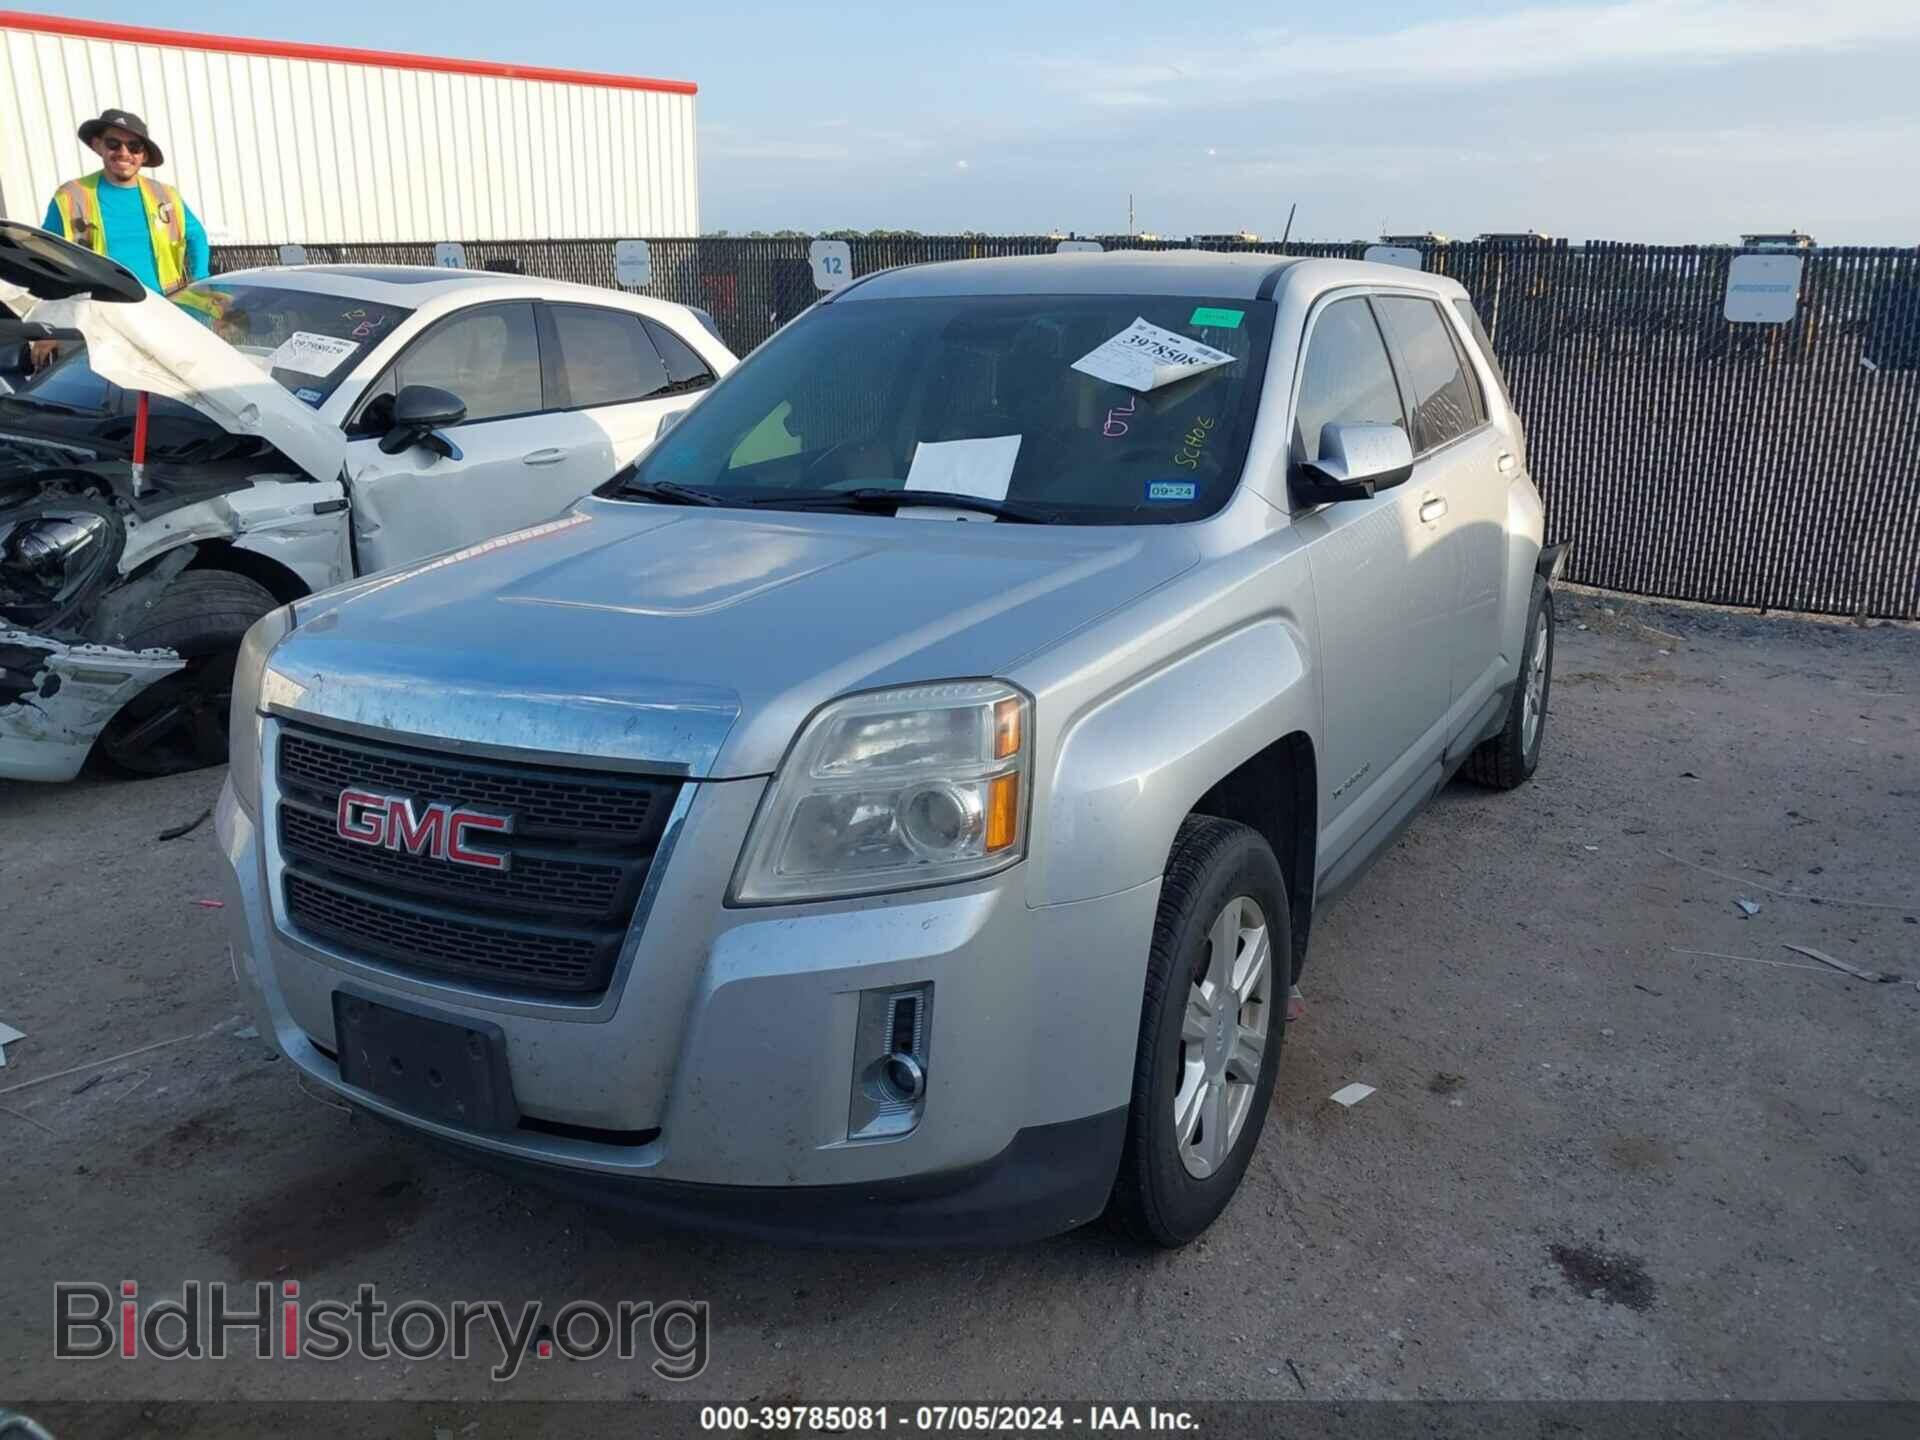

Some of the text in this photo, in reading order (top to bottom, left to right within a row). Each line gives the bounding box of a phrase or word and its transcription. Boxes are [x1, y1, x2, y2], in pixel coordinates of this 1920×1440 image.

[443, 256, 458, 268] 11
[822, 256, 842, 274] 12
[1122, 334, 1208, 365] 3978508
[1151, 487, 1192, 497] 09-24
[337, 788, 514, 872] GMC
